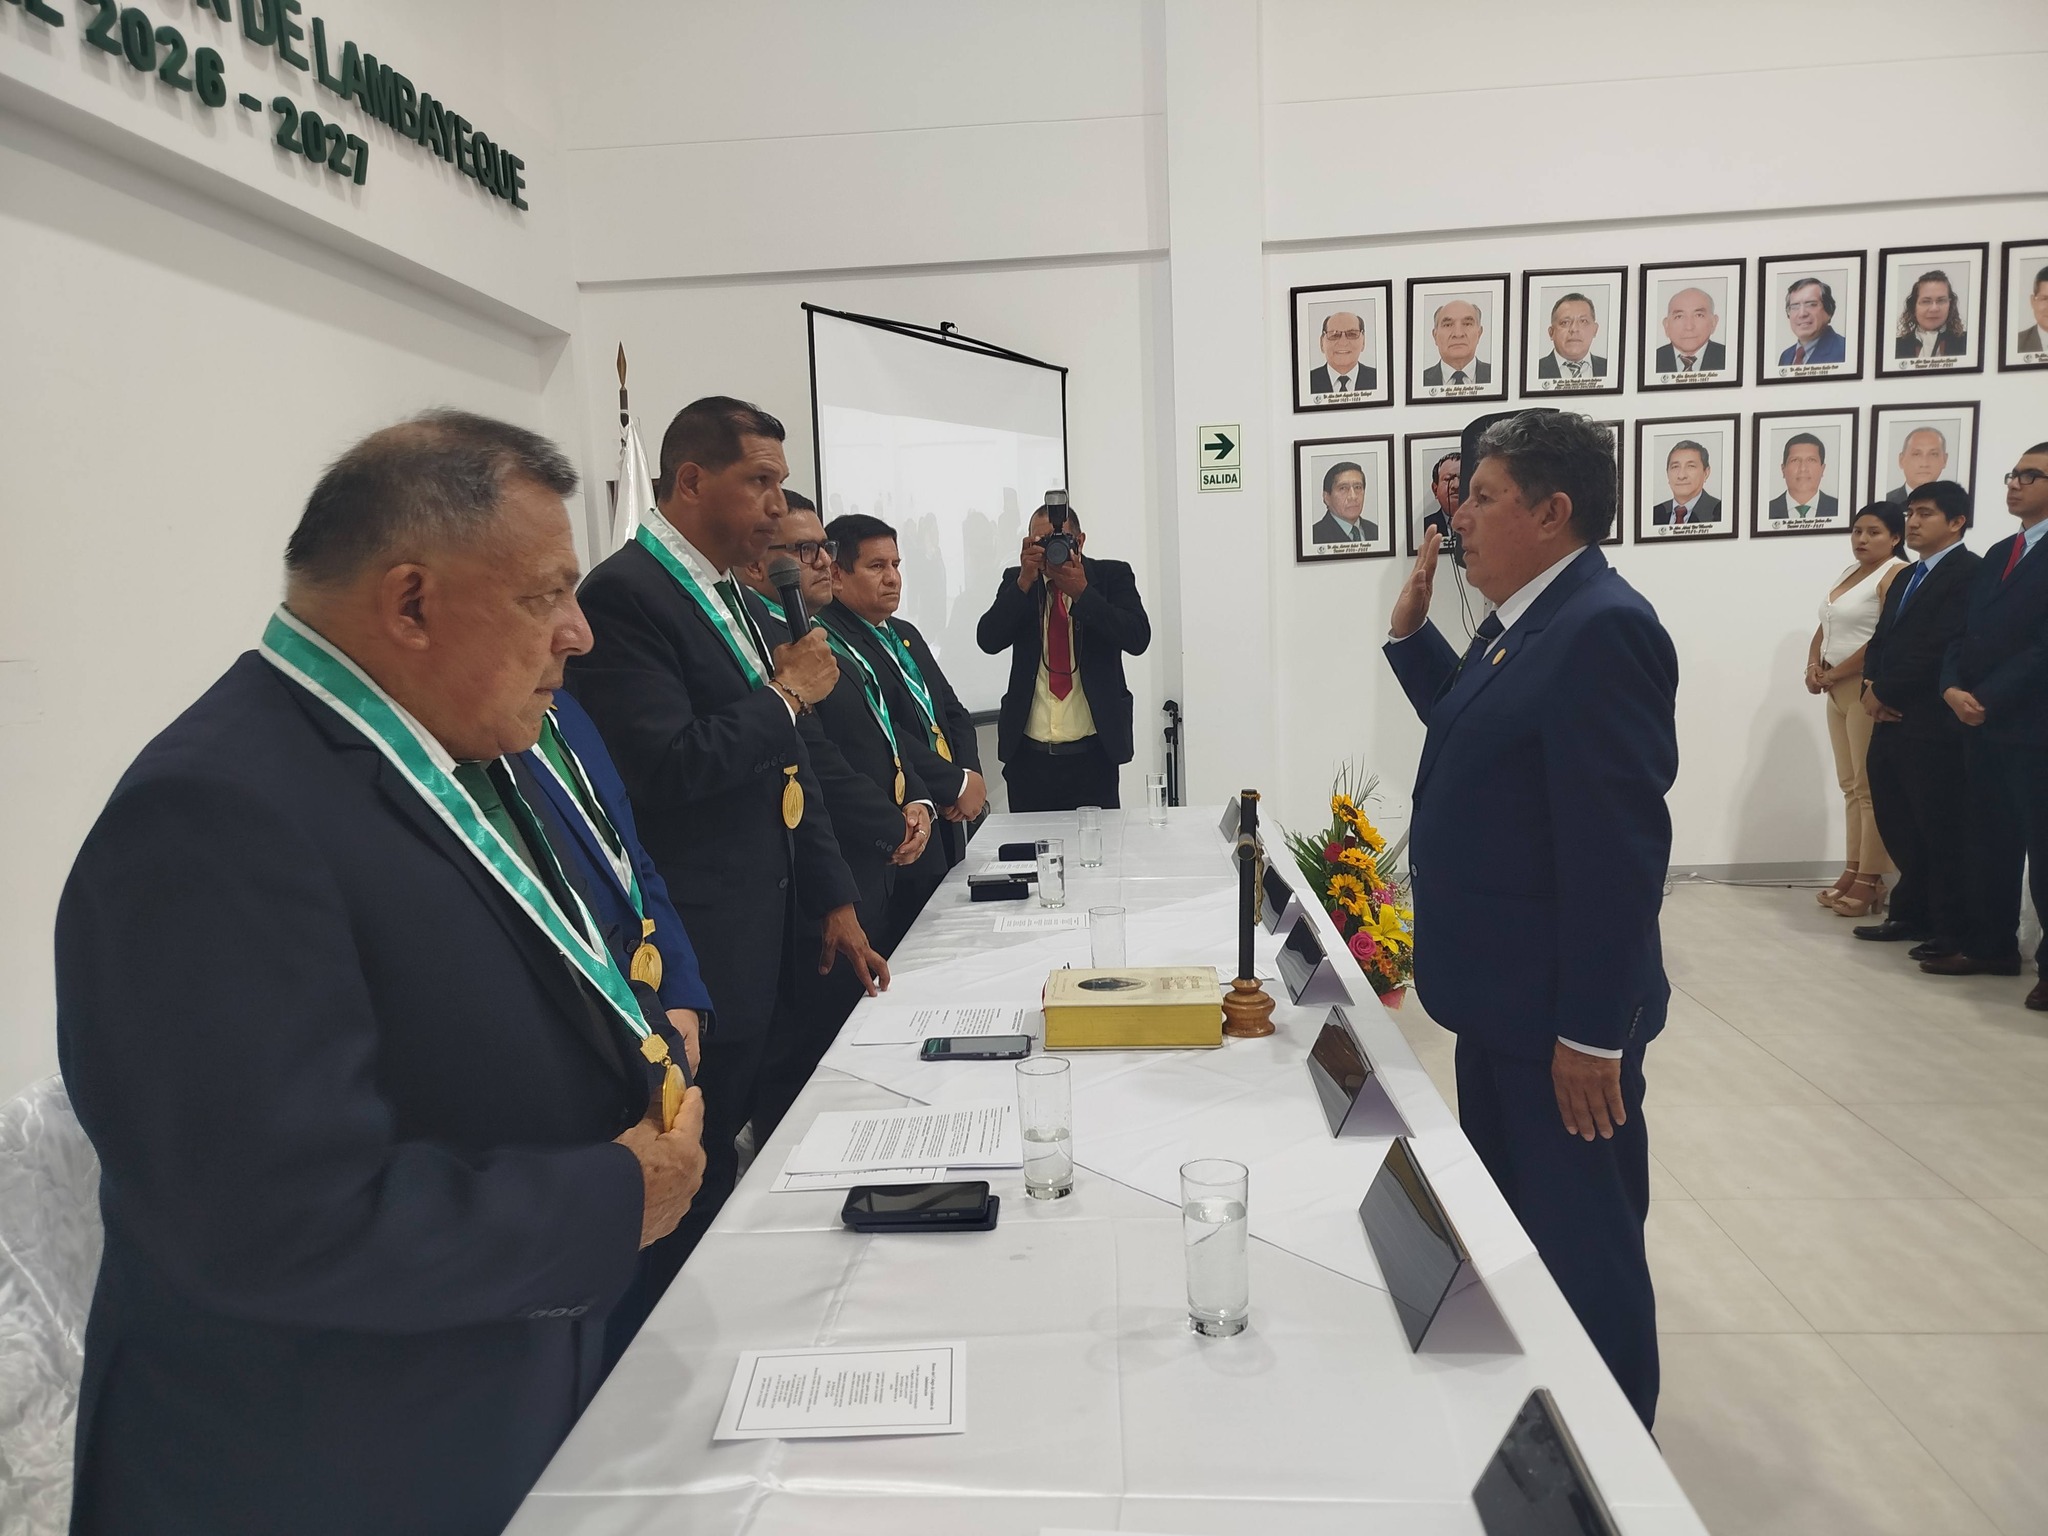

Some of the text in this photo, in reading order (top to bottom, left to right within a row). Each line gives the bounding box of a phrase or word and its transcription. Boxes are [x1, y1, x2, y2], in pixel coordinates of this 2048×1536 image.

[83, 0, 368, 186] 2026 - 2027
[241, 0, 529, 211] DE LAMBAYEQUE
[1203, 473, 1238, 485] SALIDA
